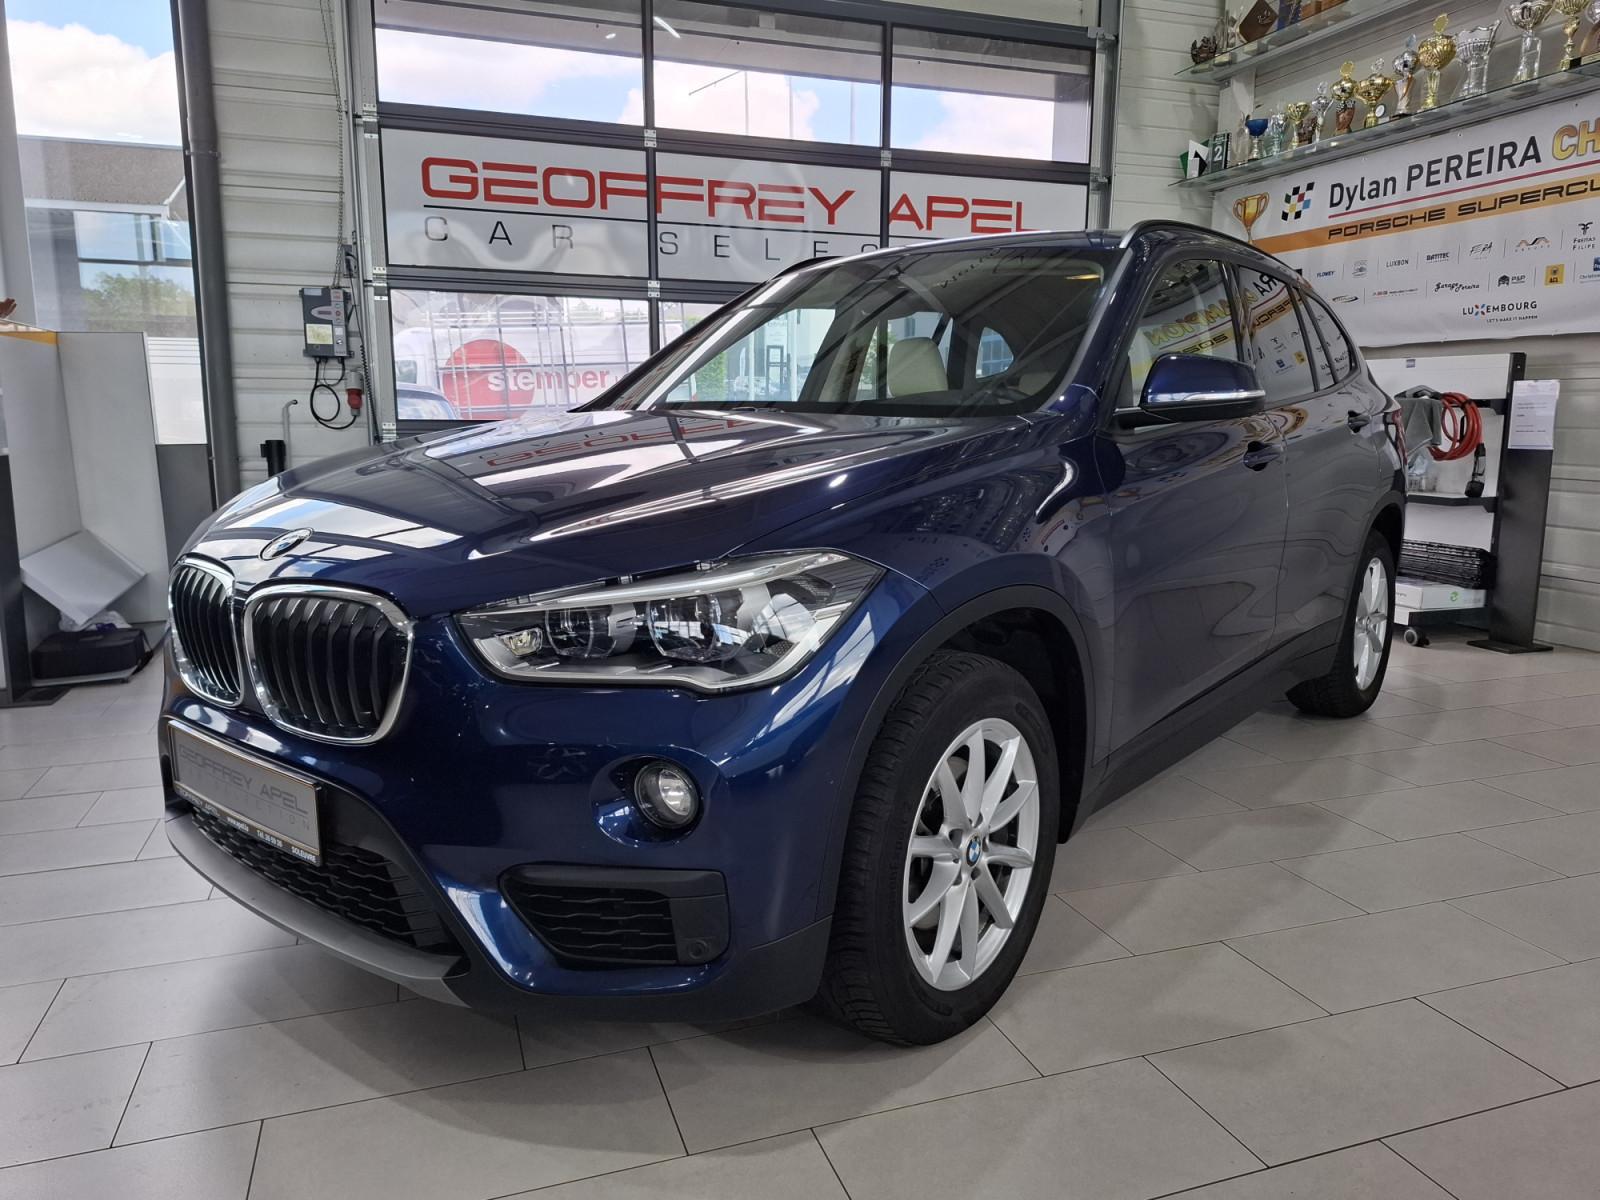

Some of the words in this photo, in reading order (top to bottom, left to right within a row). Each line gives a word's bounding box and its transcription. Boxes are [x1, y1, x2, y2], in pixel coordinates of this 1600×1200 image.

[1329, 175, 1398, 210] Dylan
[1406, 135, 1541, 191] PEREIRA
[421, 157, 856, 225] GEOFFREY
[889, 193, 1042, 233] APEL
[425, 216, 573, 249] CAR
[1328, 208, 1446, 240] PORSCHE
[1462, 300, 1538, 316] LUXEMBOURG
[487, 368, 610, 392] stemper
